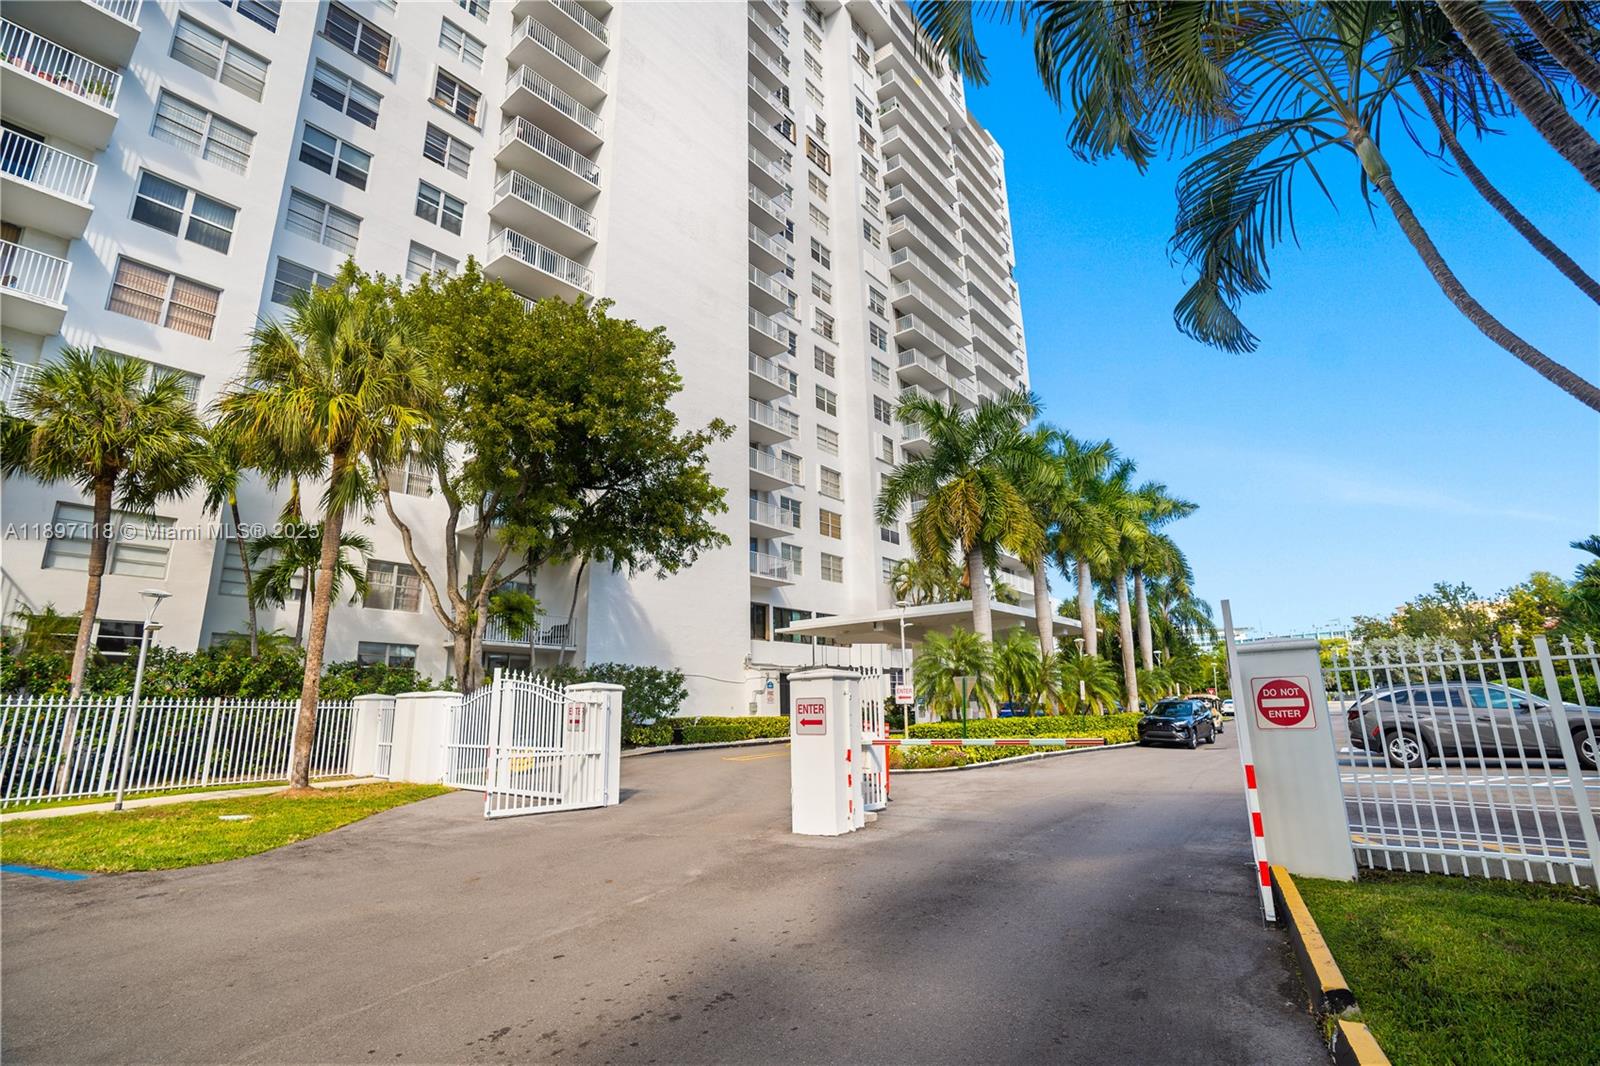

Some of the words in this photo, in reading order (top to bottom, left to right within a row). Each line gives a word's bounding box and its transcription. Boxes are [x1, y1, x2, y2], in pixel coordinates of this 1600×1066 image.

[1280, 688, 1299, 696] NOT
[797, 703, 825, 715] ENTER
[1268, 710, 1301, 718] ENTER
